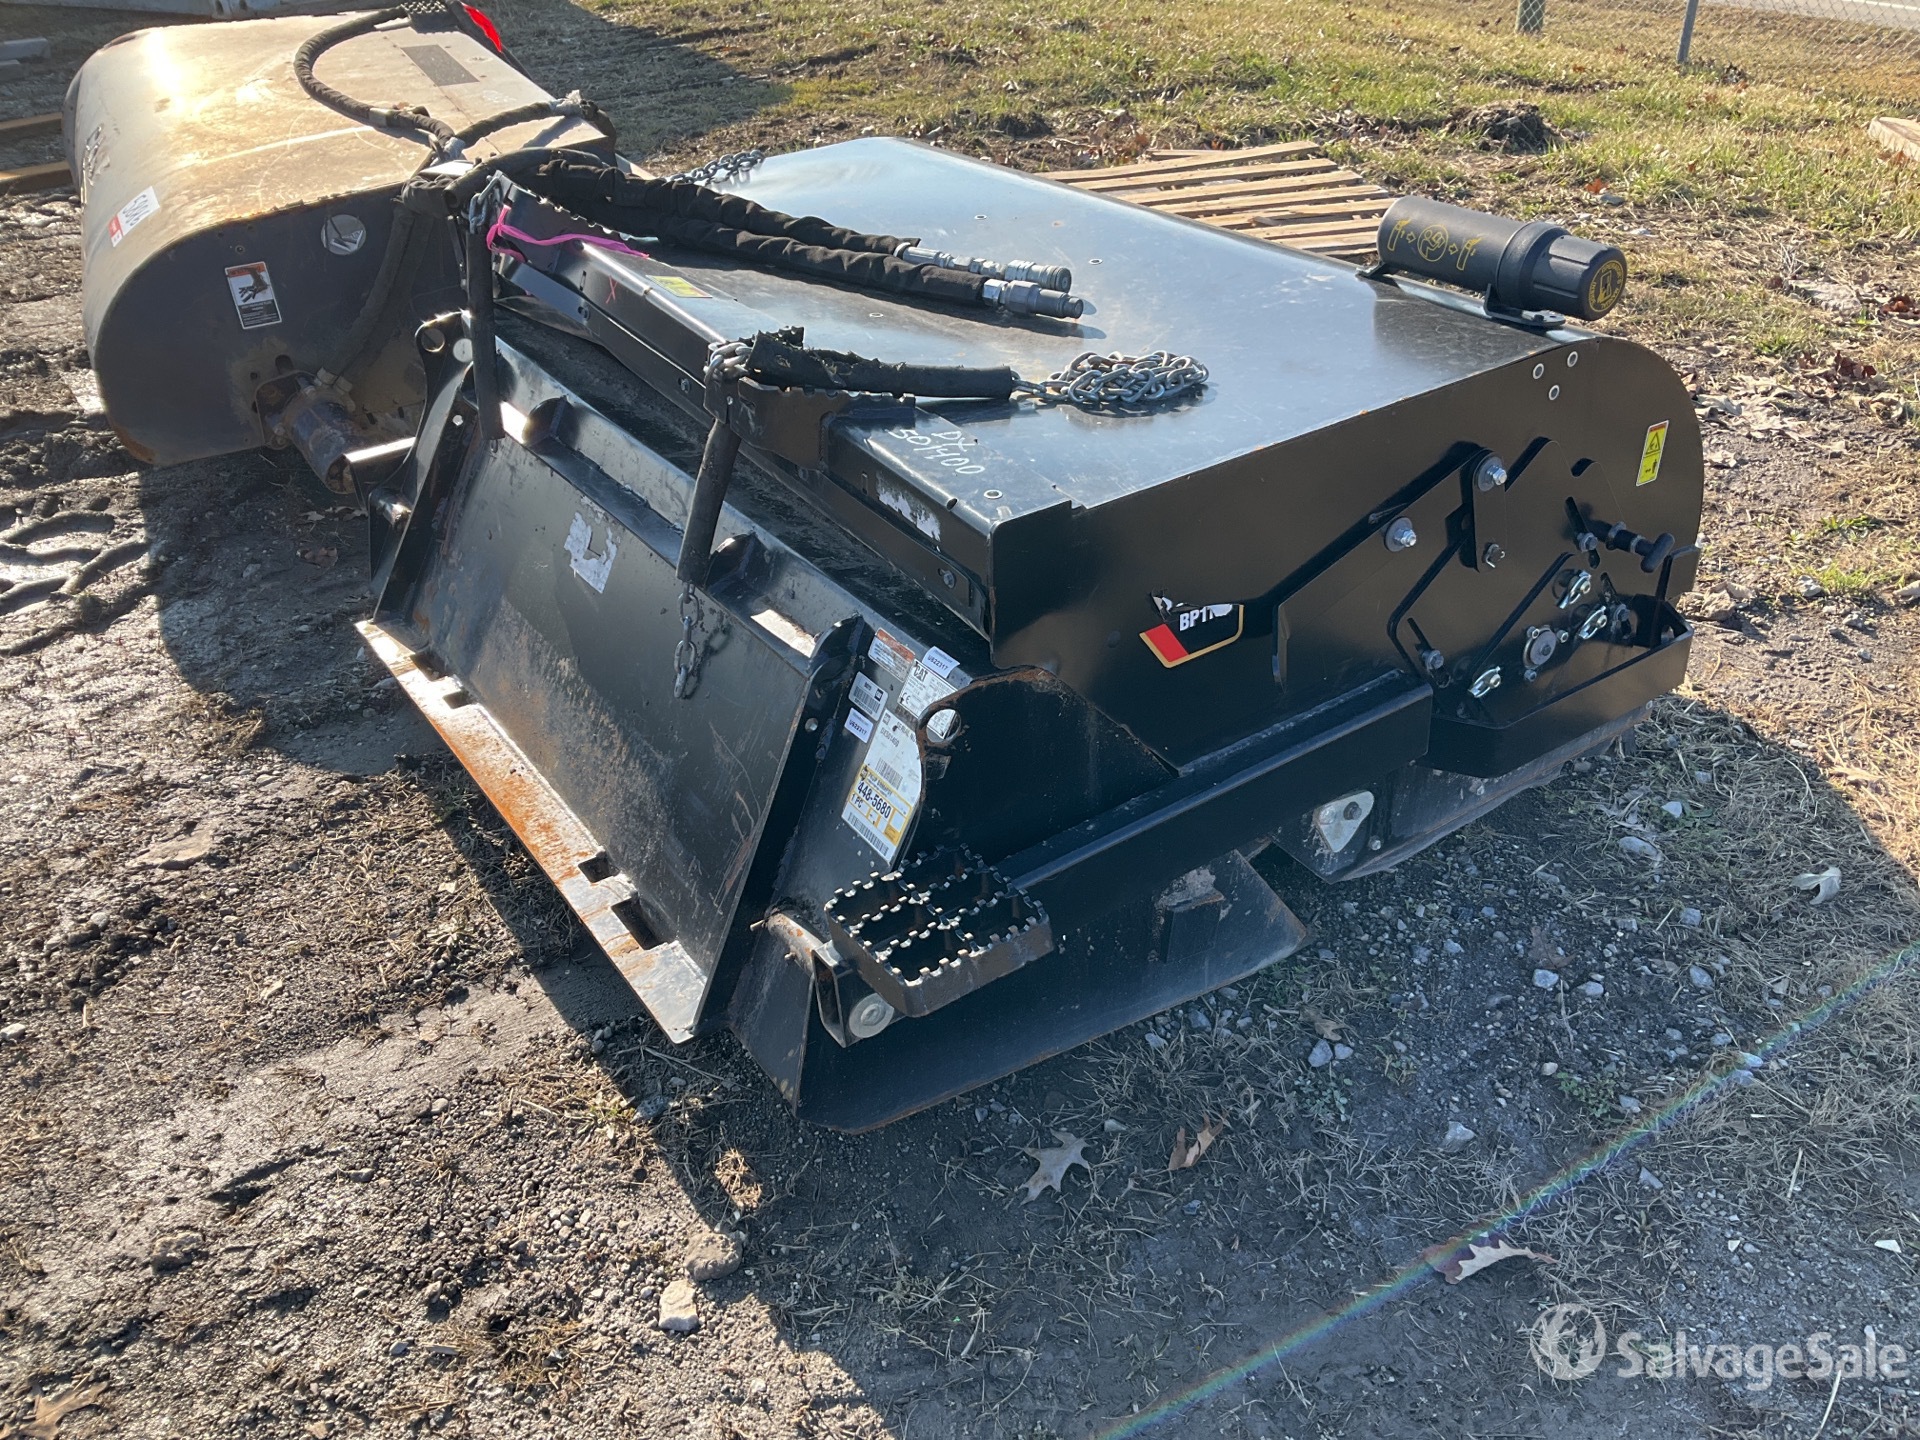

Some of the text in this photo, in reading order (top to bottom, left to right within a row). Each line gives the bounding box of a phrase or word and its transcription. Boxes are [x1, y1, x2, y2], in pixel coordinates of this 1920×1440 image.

[914, 666, 929, 682] CAT
[854, 796, 864, 809] PC
[857, 781, 892, 819] 448-5680
